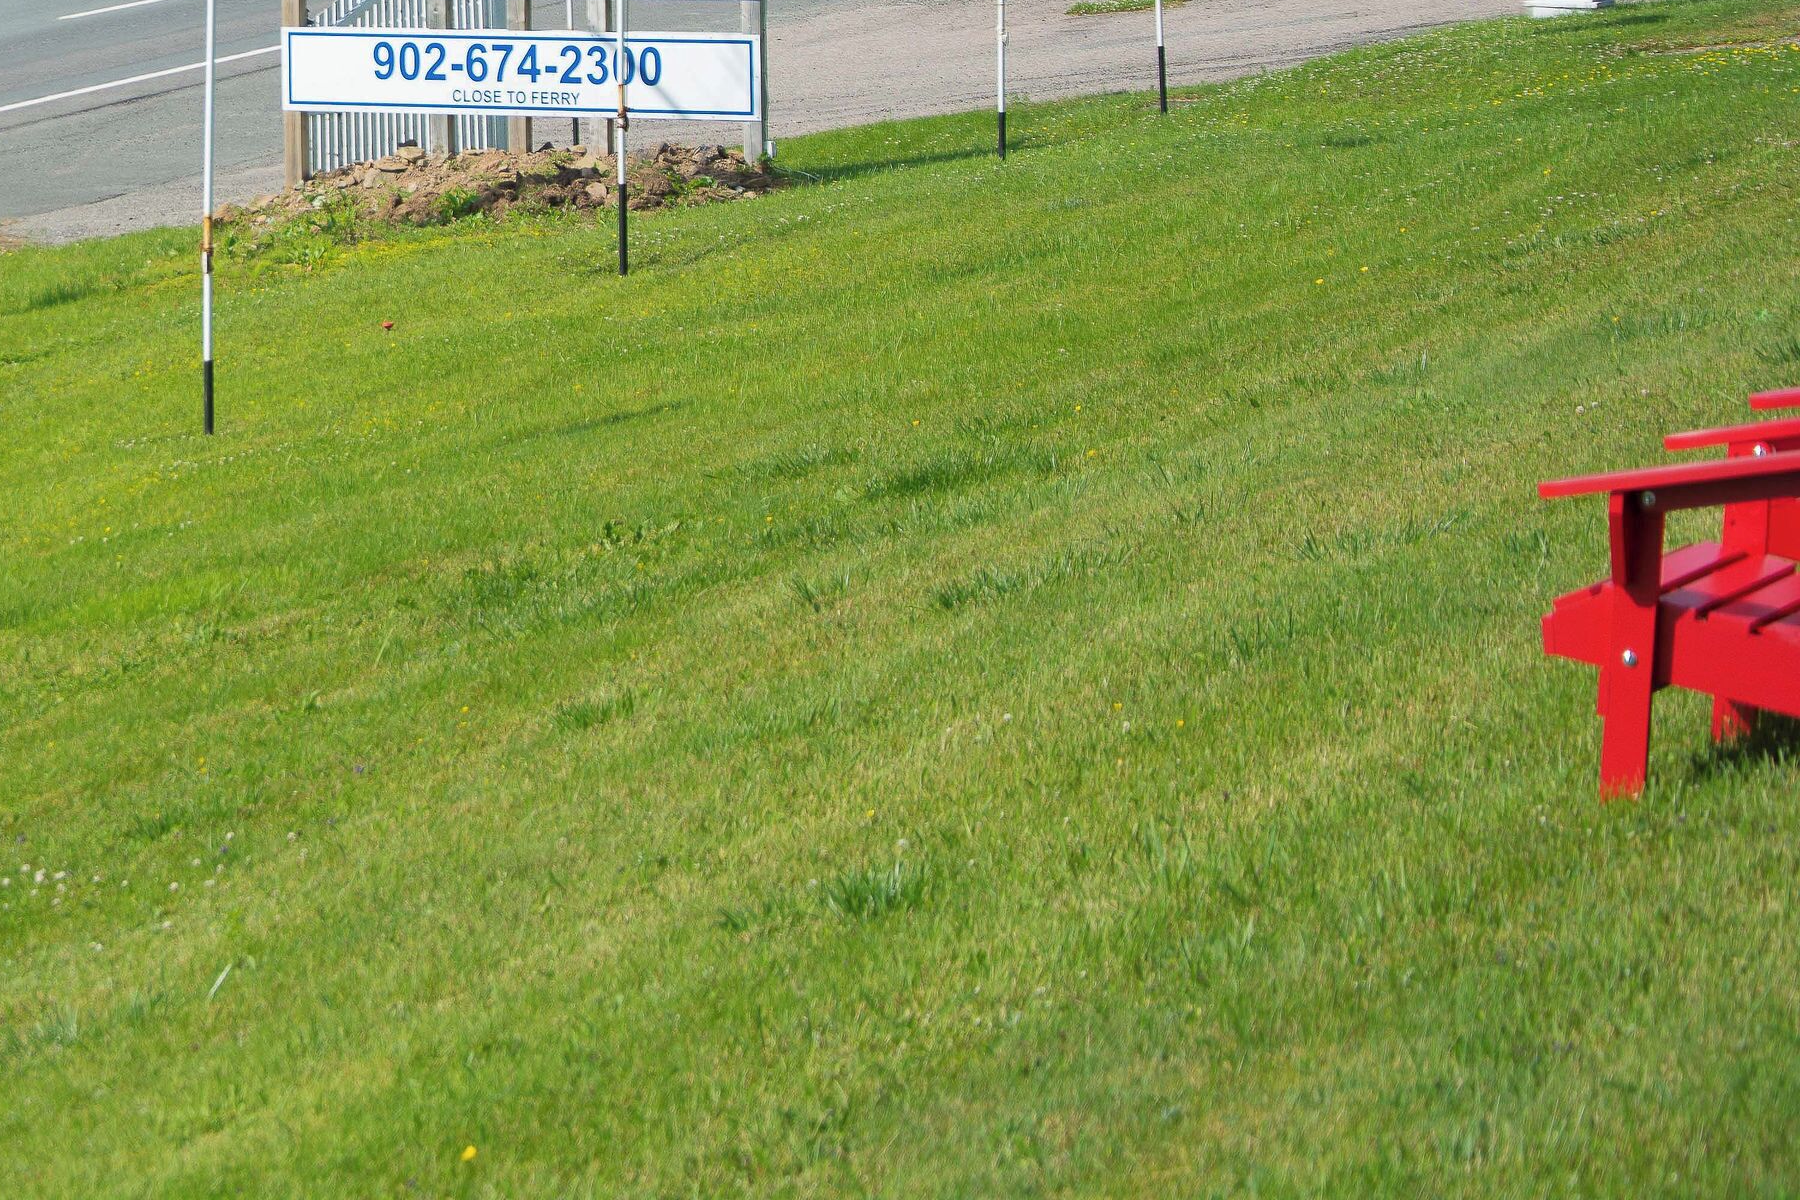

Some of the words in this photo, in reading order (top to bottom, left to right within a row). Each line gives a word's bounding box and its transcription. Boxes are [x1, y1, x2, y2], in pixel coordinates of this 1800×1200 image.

[373, 41, 663, 87] 902-674-2300
[452, 89, 502, 104] CLOSE
[506, 90, 527, 105] TO
[531, 91, 580, 106] FERRY
